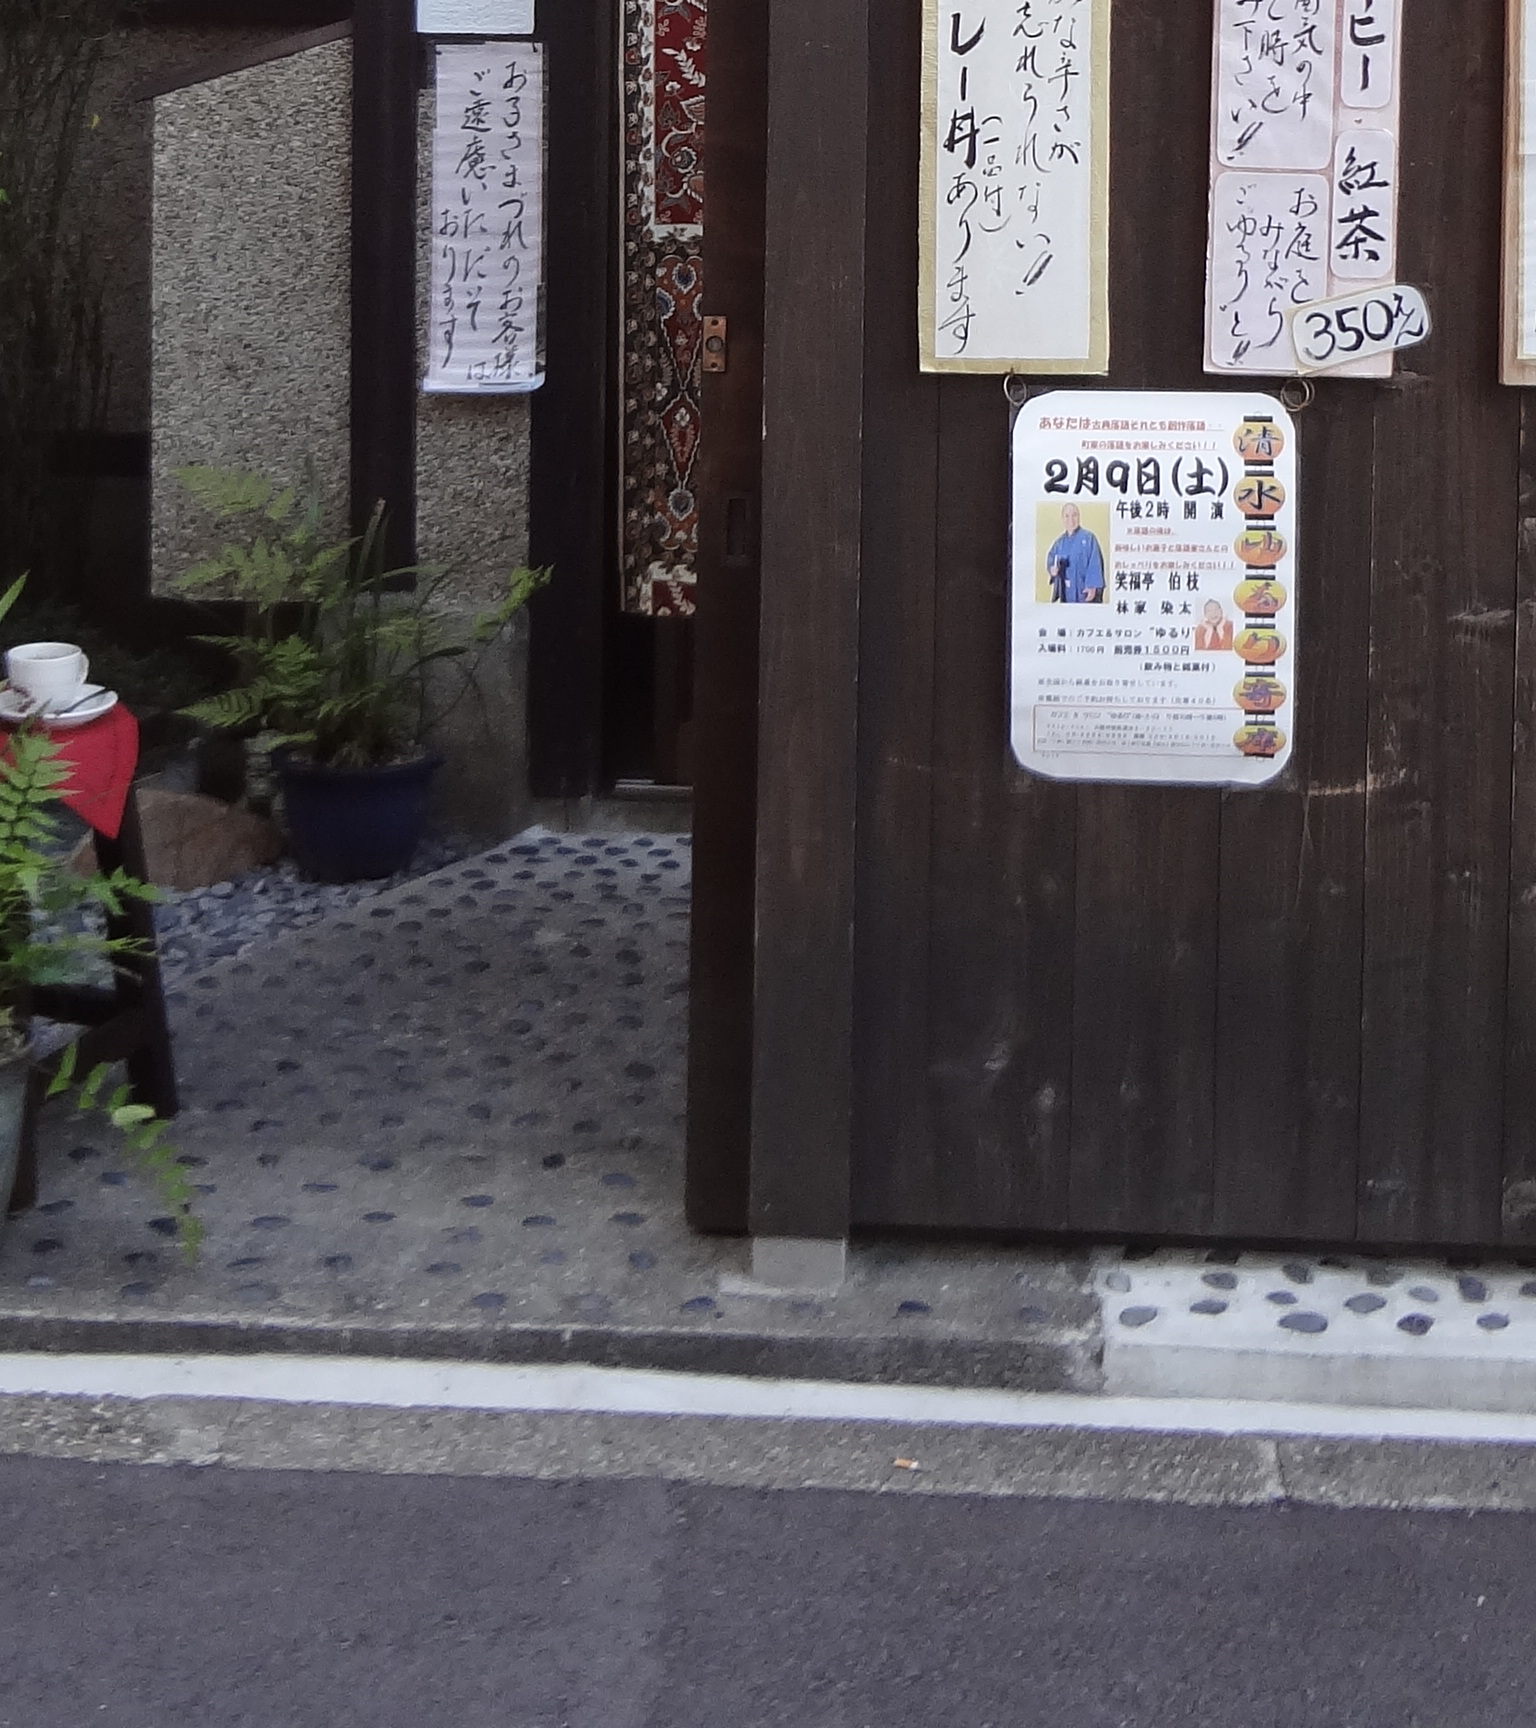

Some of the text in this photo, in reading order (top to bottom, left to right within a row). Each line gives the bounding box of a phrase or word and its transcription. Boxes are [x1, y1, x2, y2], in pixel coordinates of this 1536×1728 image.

[1285, 187, 1320, 303] お庭を
[1335, 146, 1389, 262] 紅茶
[438, 208, 459, 369] おります
[1305, 292, 1424, 361] 350えん
[1043, 456, 1230, 497] 2月9日(土)
